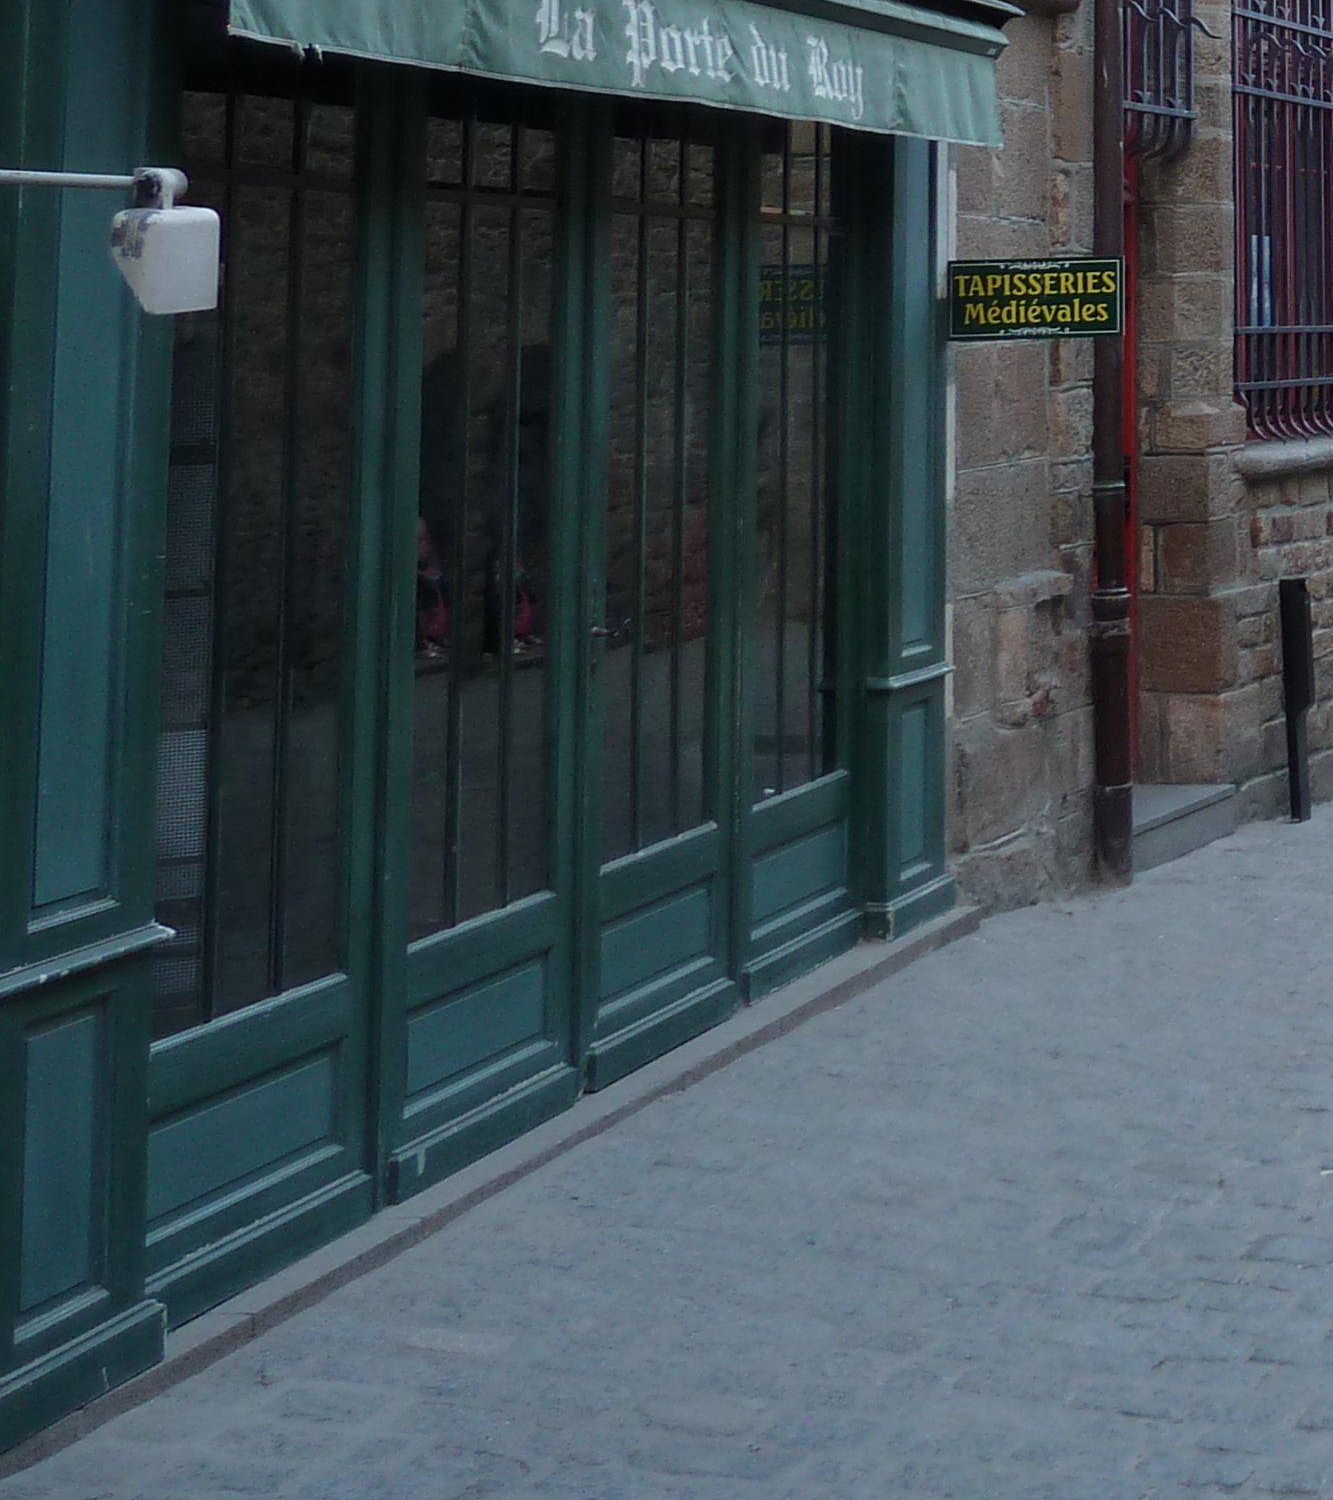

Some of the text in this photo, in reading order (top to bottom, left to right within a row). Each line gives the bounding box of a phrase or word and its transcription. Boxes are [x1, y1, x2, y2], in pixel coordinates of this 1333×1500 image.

[748, 22, 791, 92] du
[806, 34, 864, 120] Roy
[954, 271, 1117, 298] TAPISSERIES
[963, 298, 1110, 326] Médiévales
